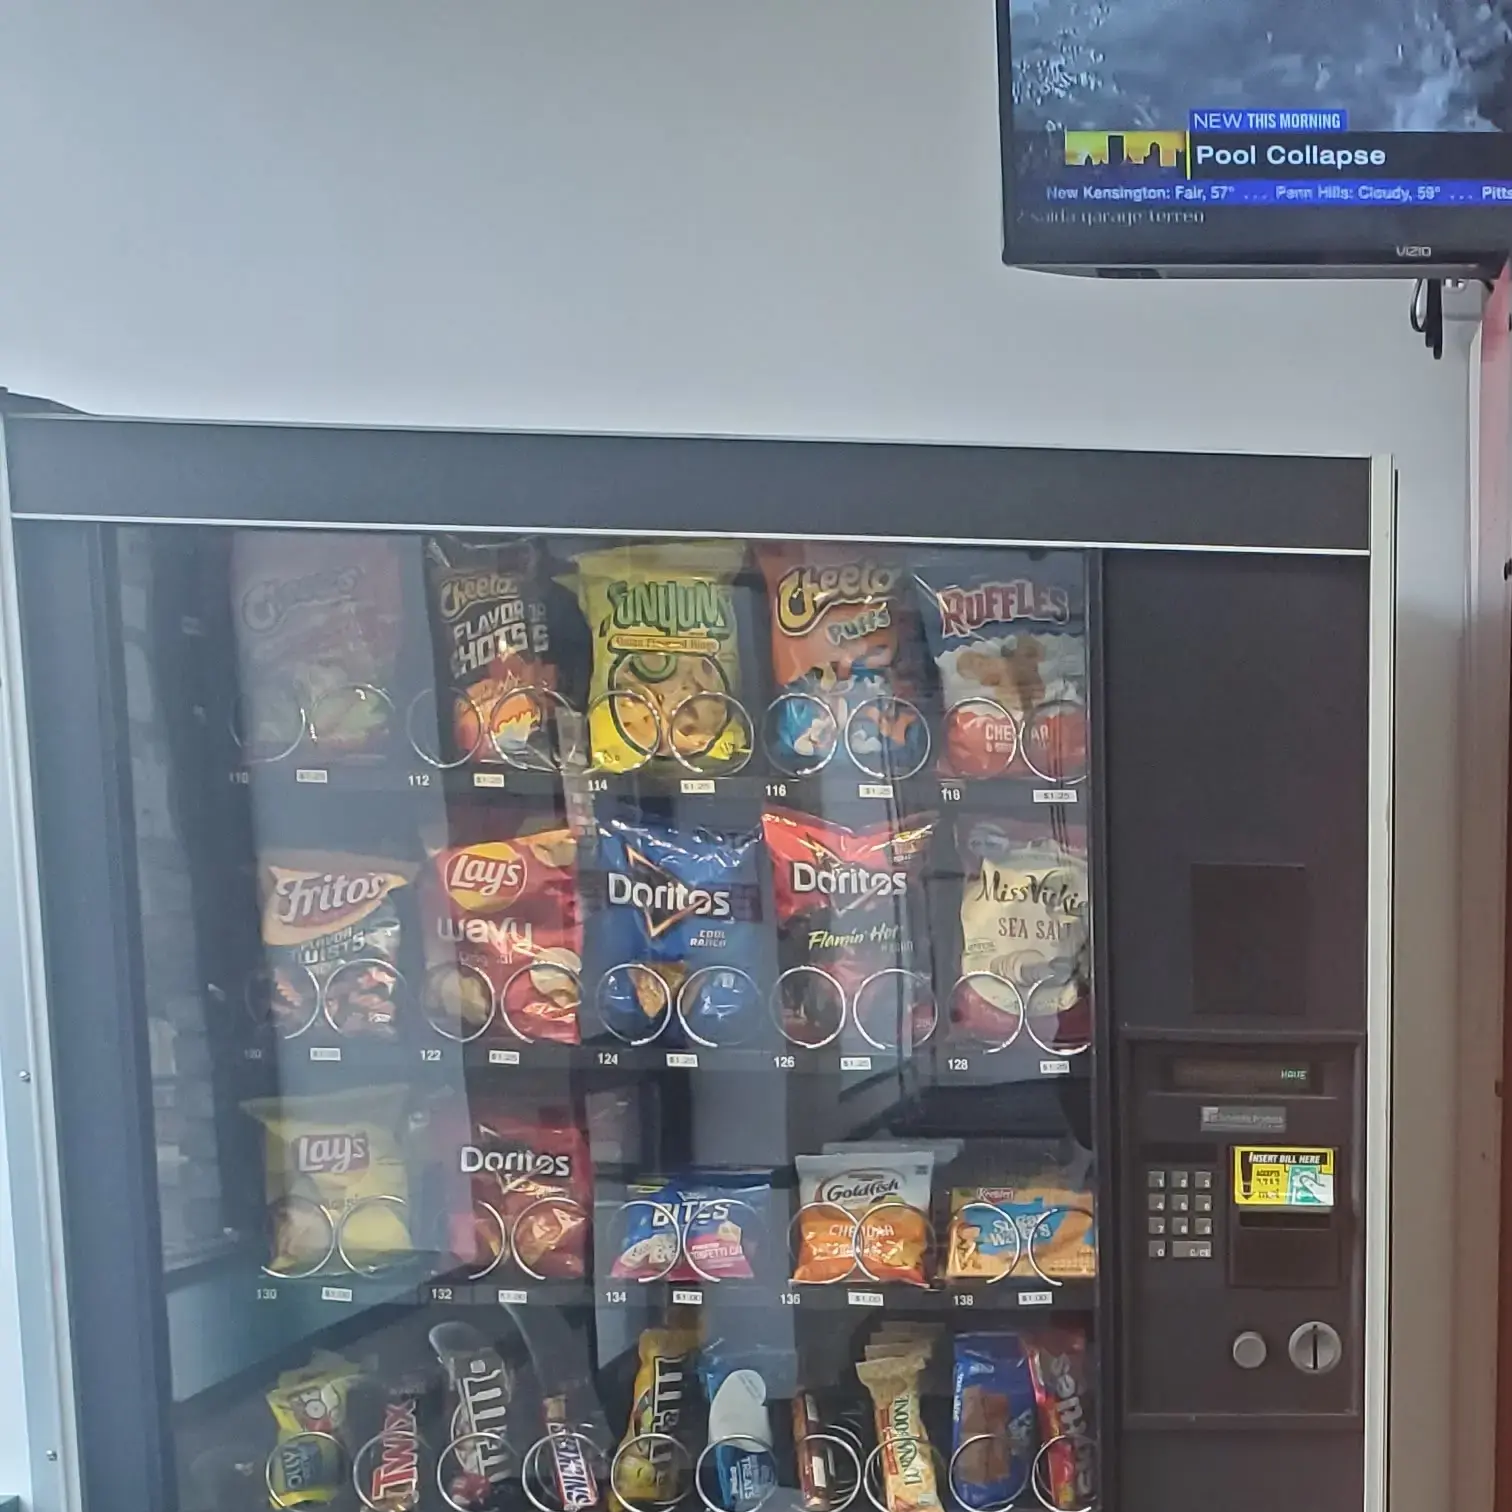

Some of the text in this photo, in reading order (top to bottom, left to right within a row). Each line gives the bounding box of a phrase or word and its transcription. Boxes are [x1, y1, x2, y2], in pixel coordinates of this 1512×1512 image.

[1194, 113, 1340, 129] NEW THIS MORNING
[1197, 145, 1386, 169] Pool Collapse
[1084, 186, 1171, 202] Kensington:
[1175, 185, 1207, 201] Fair,
[1358, 186, 1412, 202] Cloudy,
[1396, 246, 1431, 257] VIZIO
[939, 578, 1069, 638] RUFFLES
[453, 600, 525, 642] FLAVOR
[408, 774, 430, 787] 112
[587, 779, 608, 791] 114
[765, 784, 787, 797] 116
[451, 854, 522, 896] Lay's
[793, 862, 906, 896] Doritos
[608, 872, 730, 916] Doritos
[999, 917, 1028, 939] SEA
[420, 1050, 441, 1061] 122
[598, 1053, 618, 1065] 124
[774, 1057, 795, 1069] 126
[948, 1059, 968, 1071] 128
[461, 1147, 569, 1177] Doritos
[1249, 1152, 1320, 1164] INSERT BILL HERE
[827, 1179, 899, 1202] Goldfish
[653, 1201, 730, 1227] BITES
[257, 1289, 277, 1299] 130
[432, 1289, 452, 1300] 132
[605, 1292, 626, 1303] 134
[780, 1294, 800, 1305] 136
[954, 1295, 973, 1306] 138
[373, 1399, 417, 1500] TWIX
